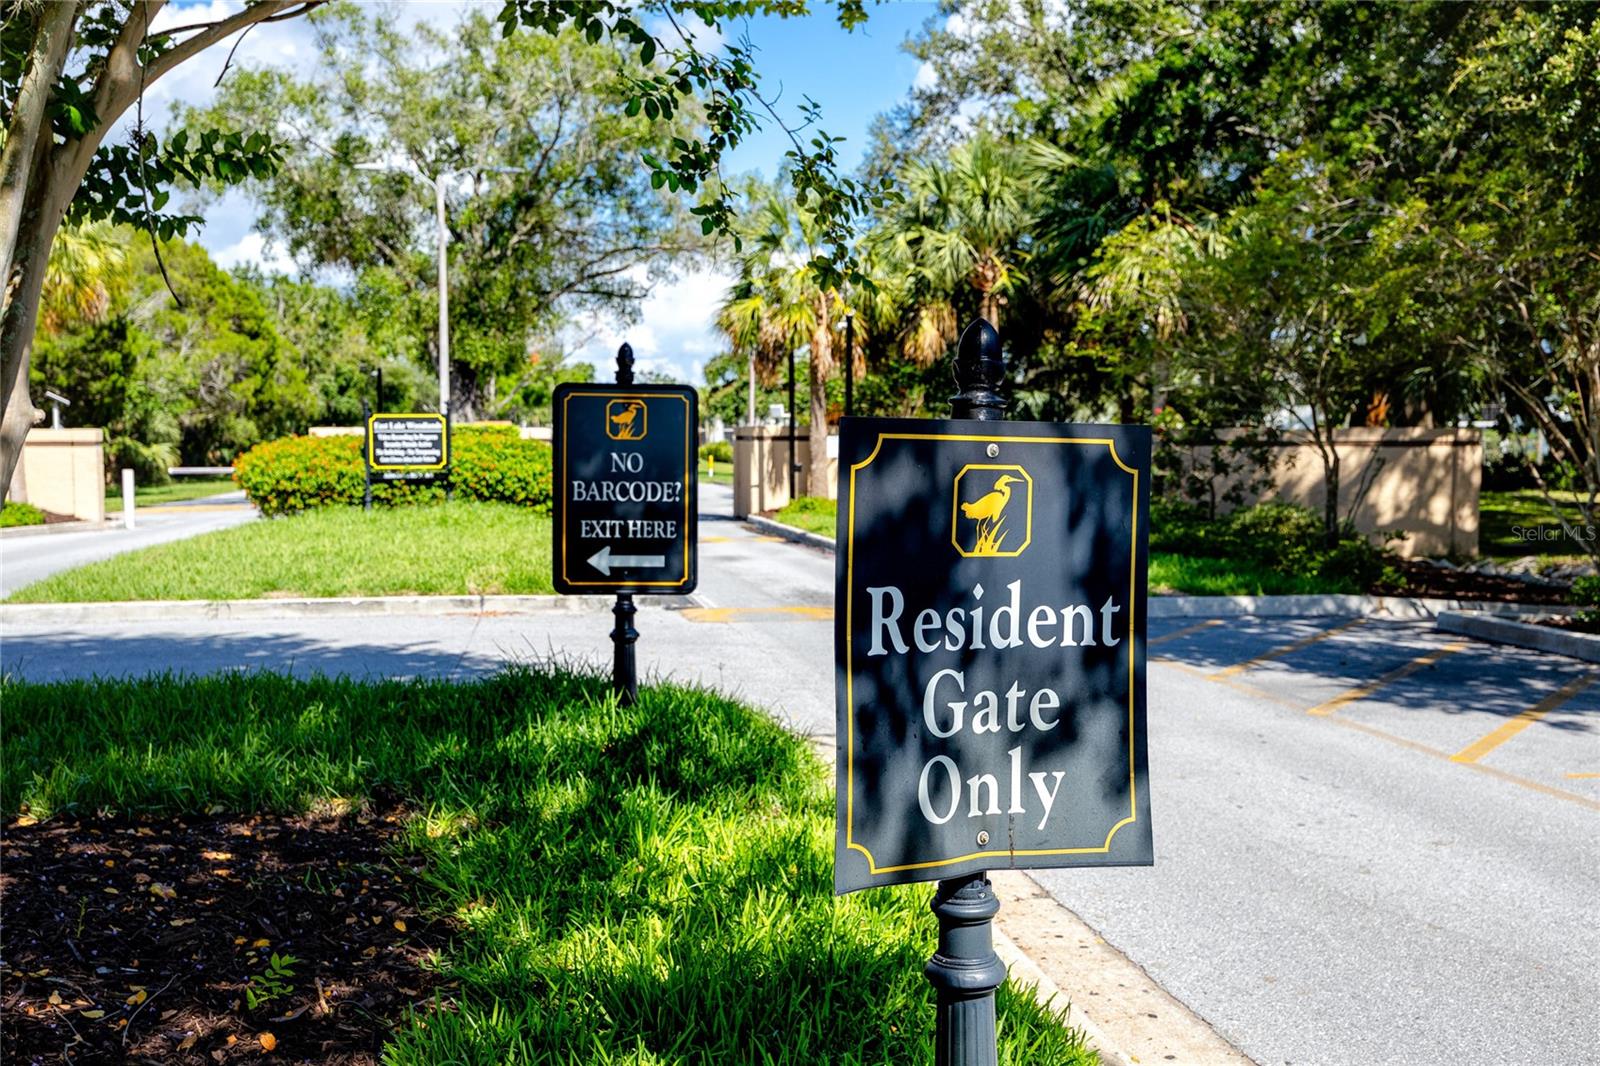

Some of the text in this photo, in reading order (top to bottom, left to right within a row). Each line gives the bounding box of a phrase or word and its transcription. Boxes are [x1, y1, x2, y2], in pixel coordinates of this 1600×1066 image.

[610, 452, 644, 473] NO
[572, 480, 682, 502] BARCODE?
[580, 519, 678, 539] EXIT HERE
[866, 579, 1121, 657] Resident
[922, 668, 1060, 739] Gate
[917, 746, 1066, 831] Only
